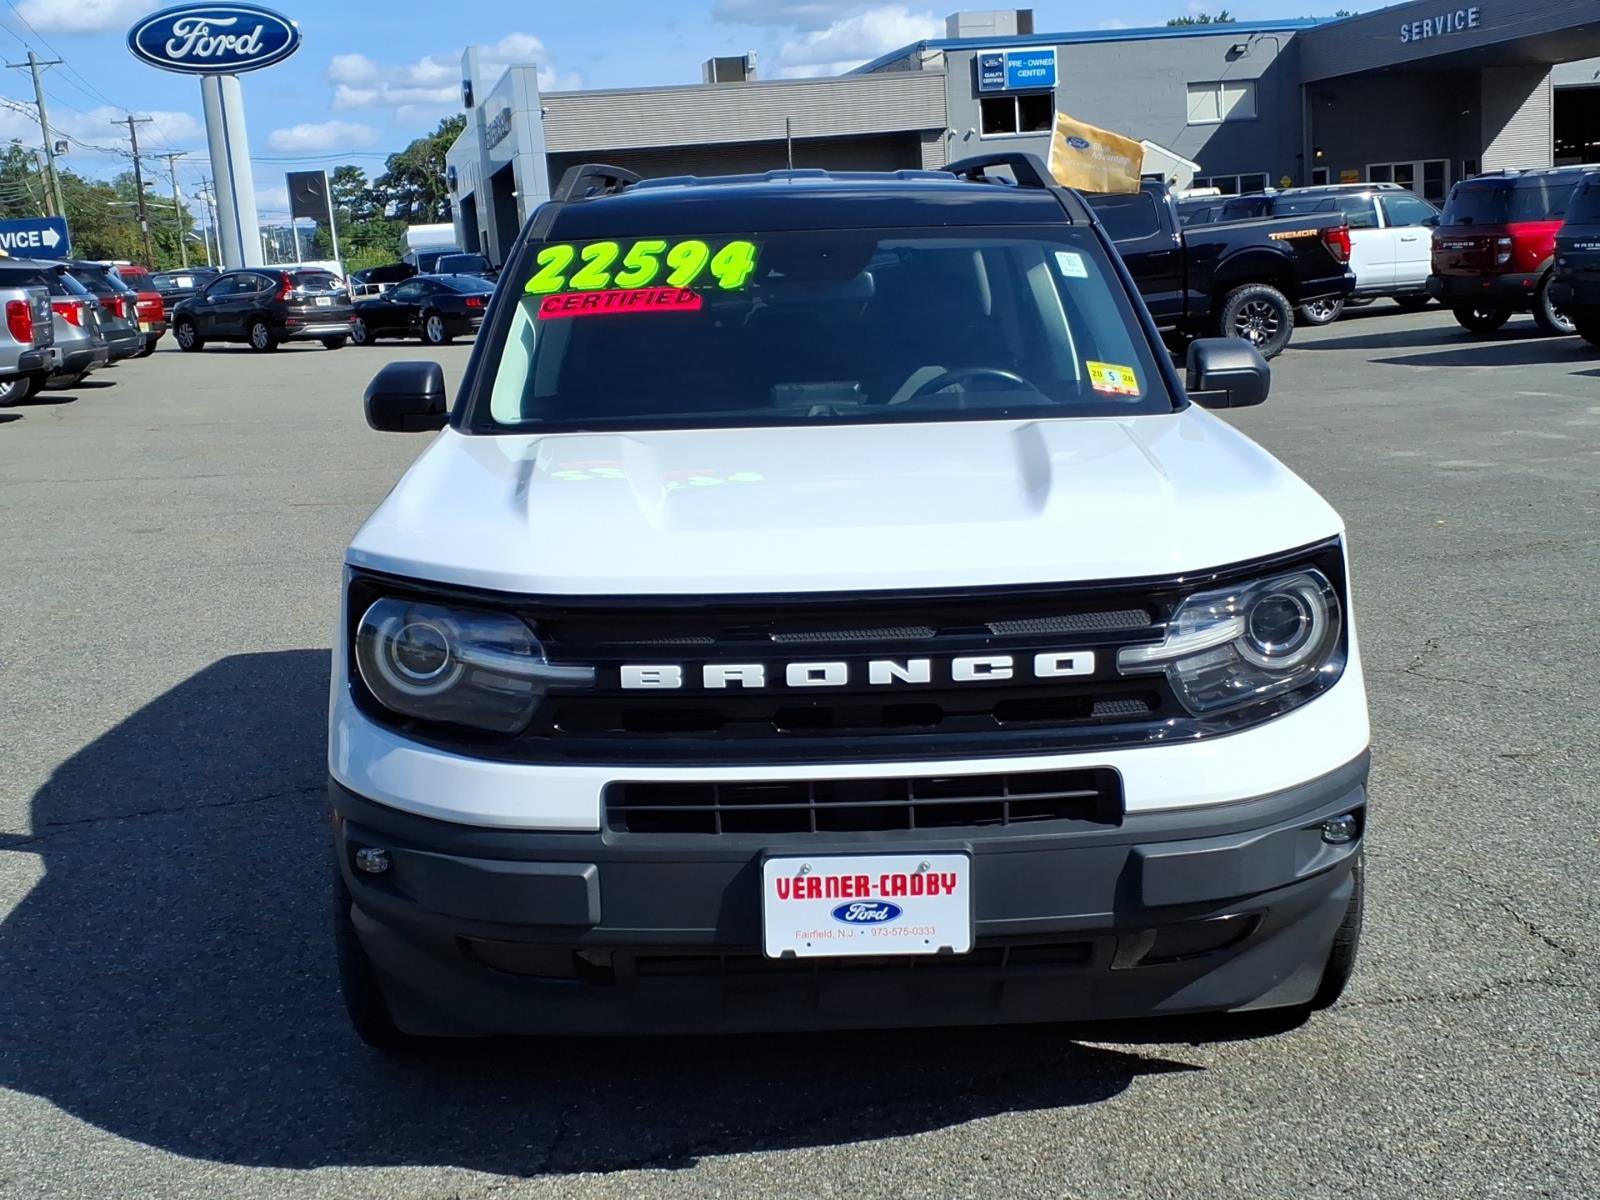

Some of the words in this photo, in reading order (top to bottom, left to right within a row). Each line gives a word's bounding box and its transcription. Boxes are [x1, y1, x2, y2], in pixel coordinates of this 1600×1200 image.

[1400, 7, 1479, 43] SERVICE
[165, 17, 264, 59] Ford
[1017, 69, 1046, 77] CENTER
[1268, 229, 1318, 240] TREMOR
[525, 240, 755, 293] 22594
[542, 288, 697, 313] CERTIFIED
[1108, 371, 1115, 382] 5
[620, 651, 1095, 689] BRONCO
[776, 873, 957, 900] VERNER-CADBY
[845, 903, 888, 920] Ford
[795, 930, 835, 940] Fairfield,
[838, 929, 856, 938] N.J.
[871, 927, 936, 936] 973-575-0333
